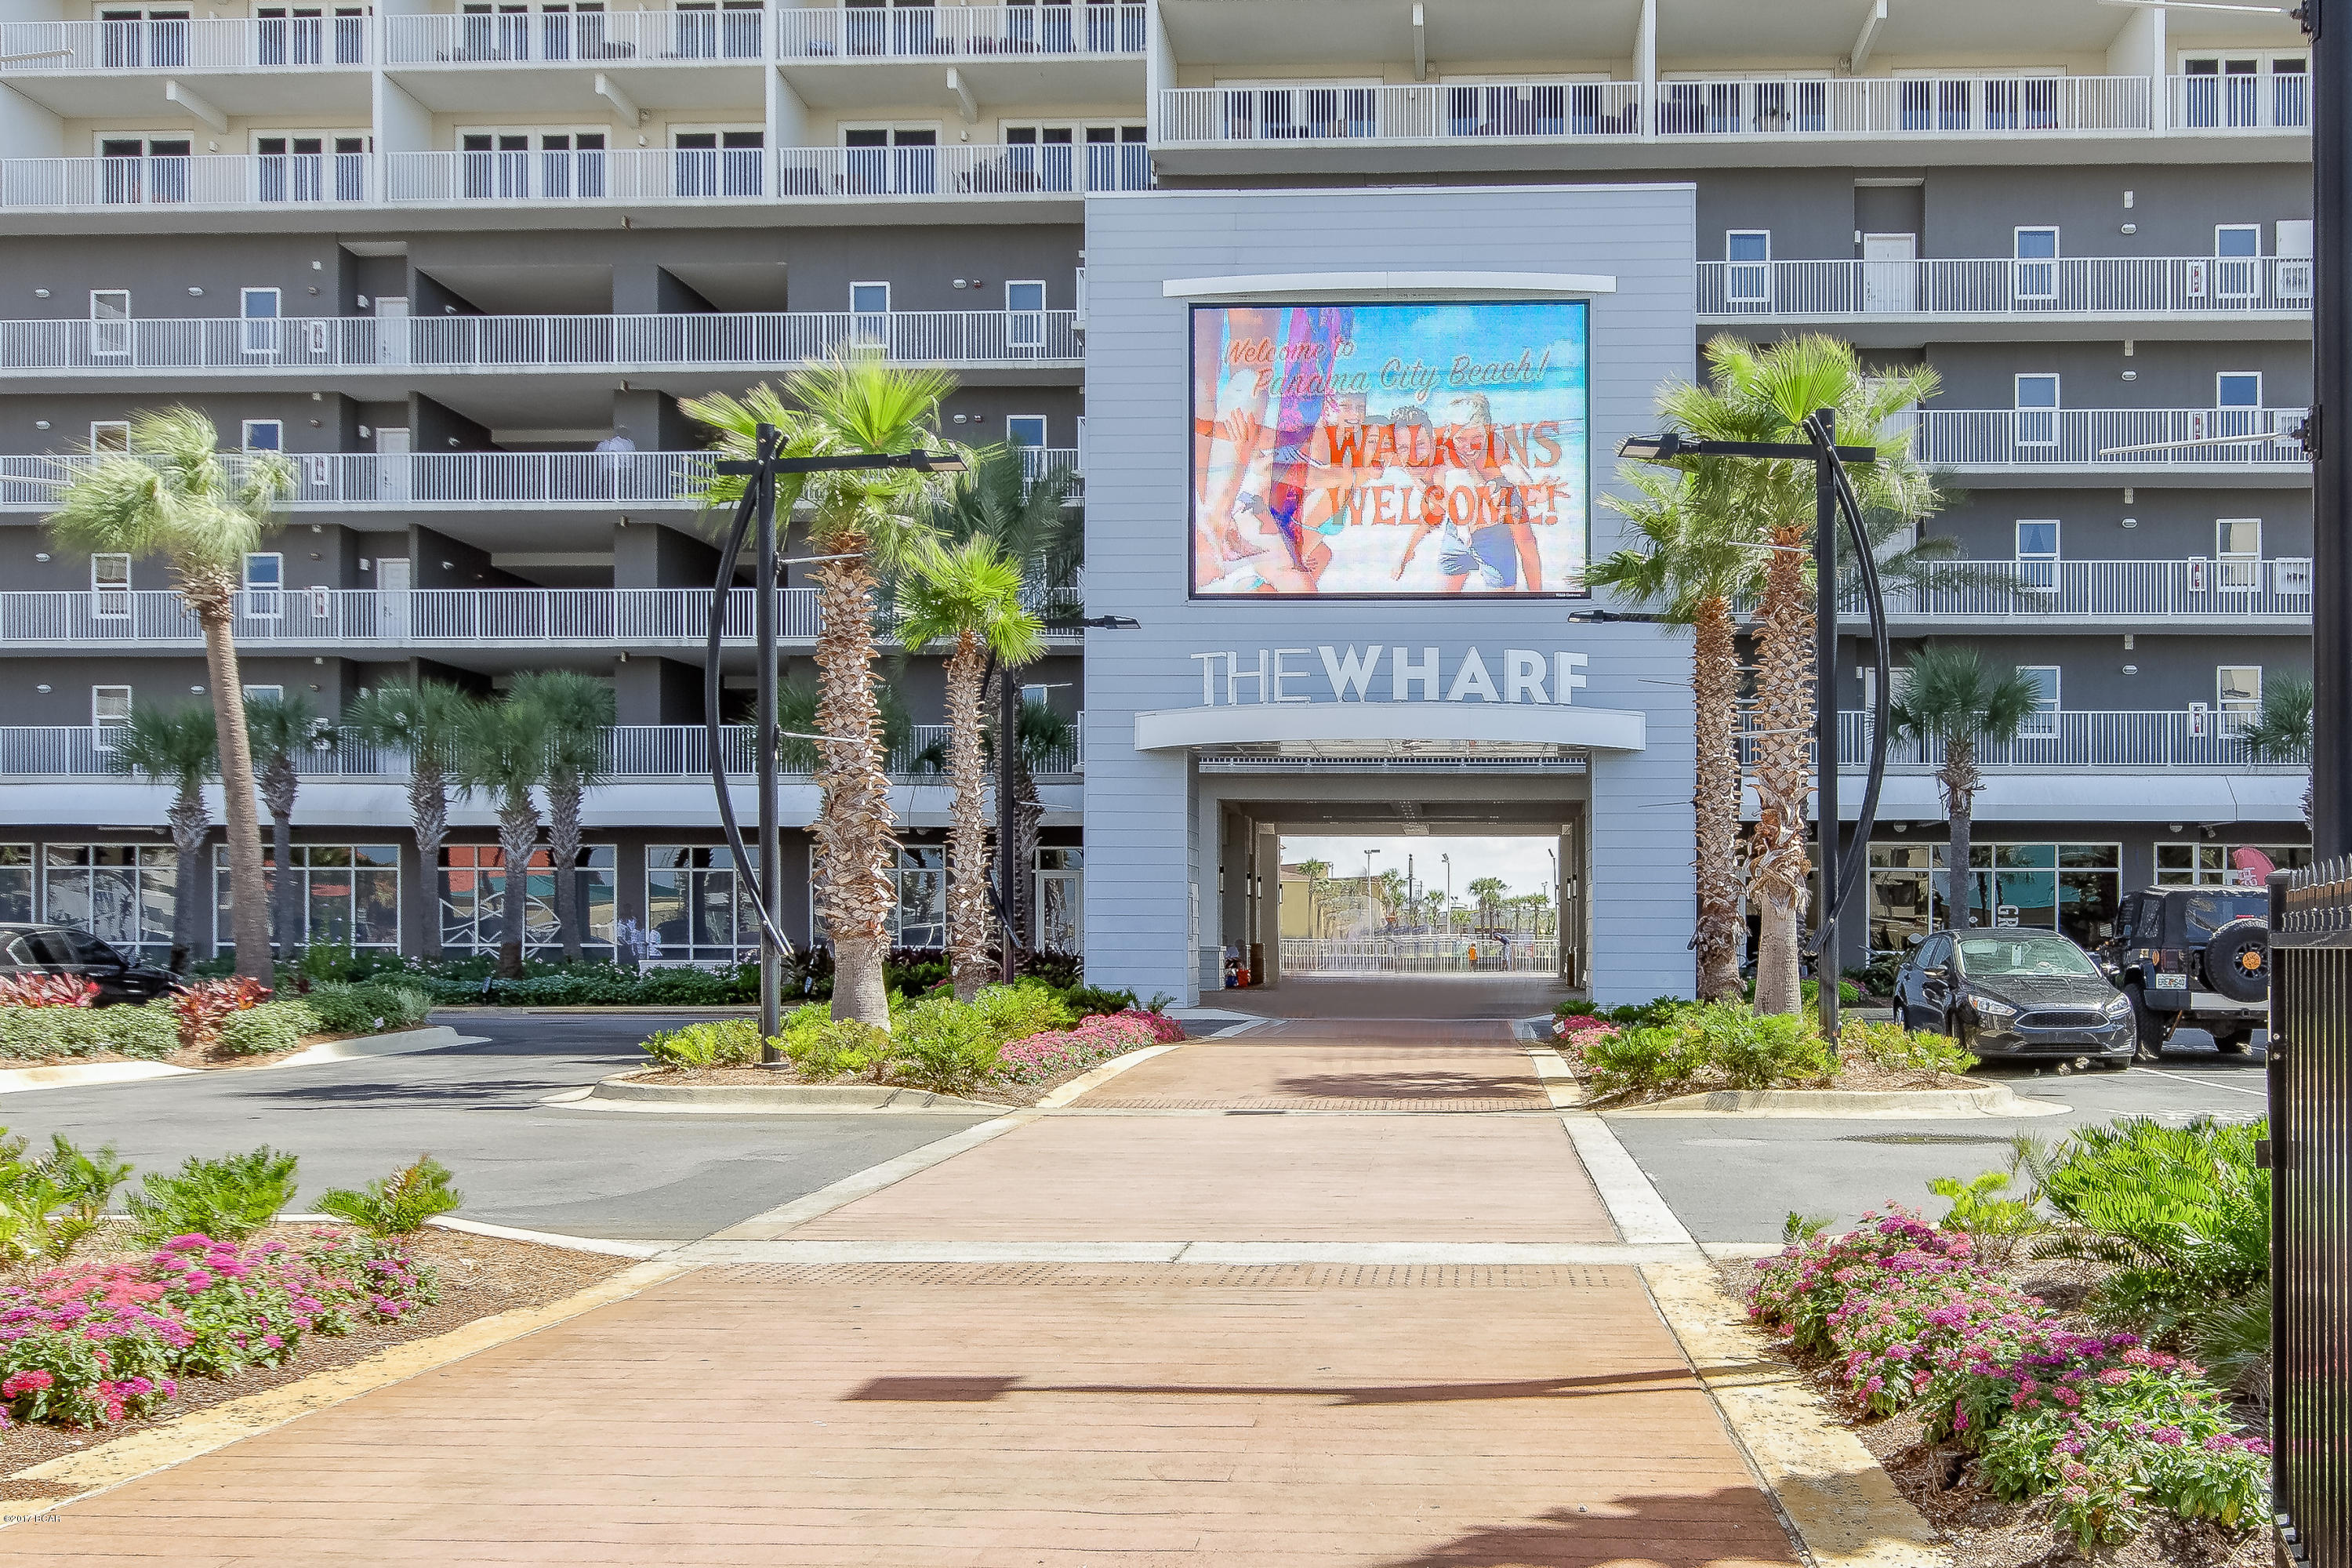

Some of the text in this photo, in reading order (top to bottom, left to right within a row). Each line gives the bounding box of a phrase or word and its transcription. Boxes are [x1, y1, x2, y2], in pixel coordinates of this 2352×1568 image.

[1224, 336, 1325, 365] Welcome
[1252, 350, 1550, 402] Panama City Beach!
[1327, 484, 1560, 526] WELCOME!
[1190, 643, 1589, 707] THE WHARF
